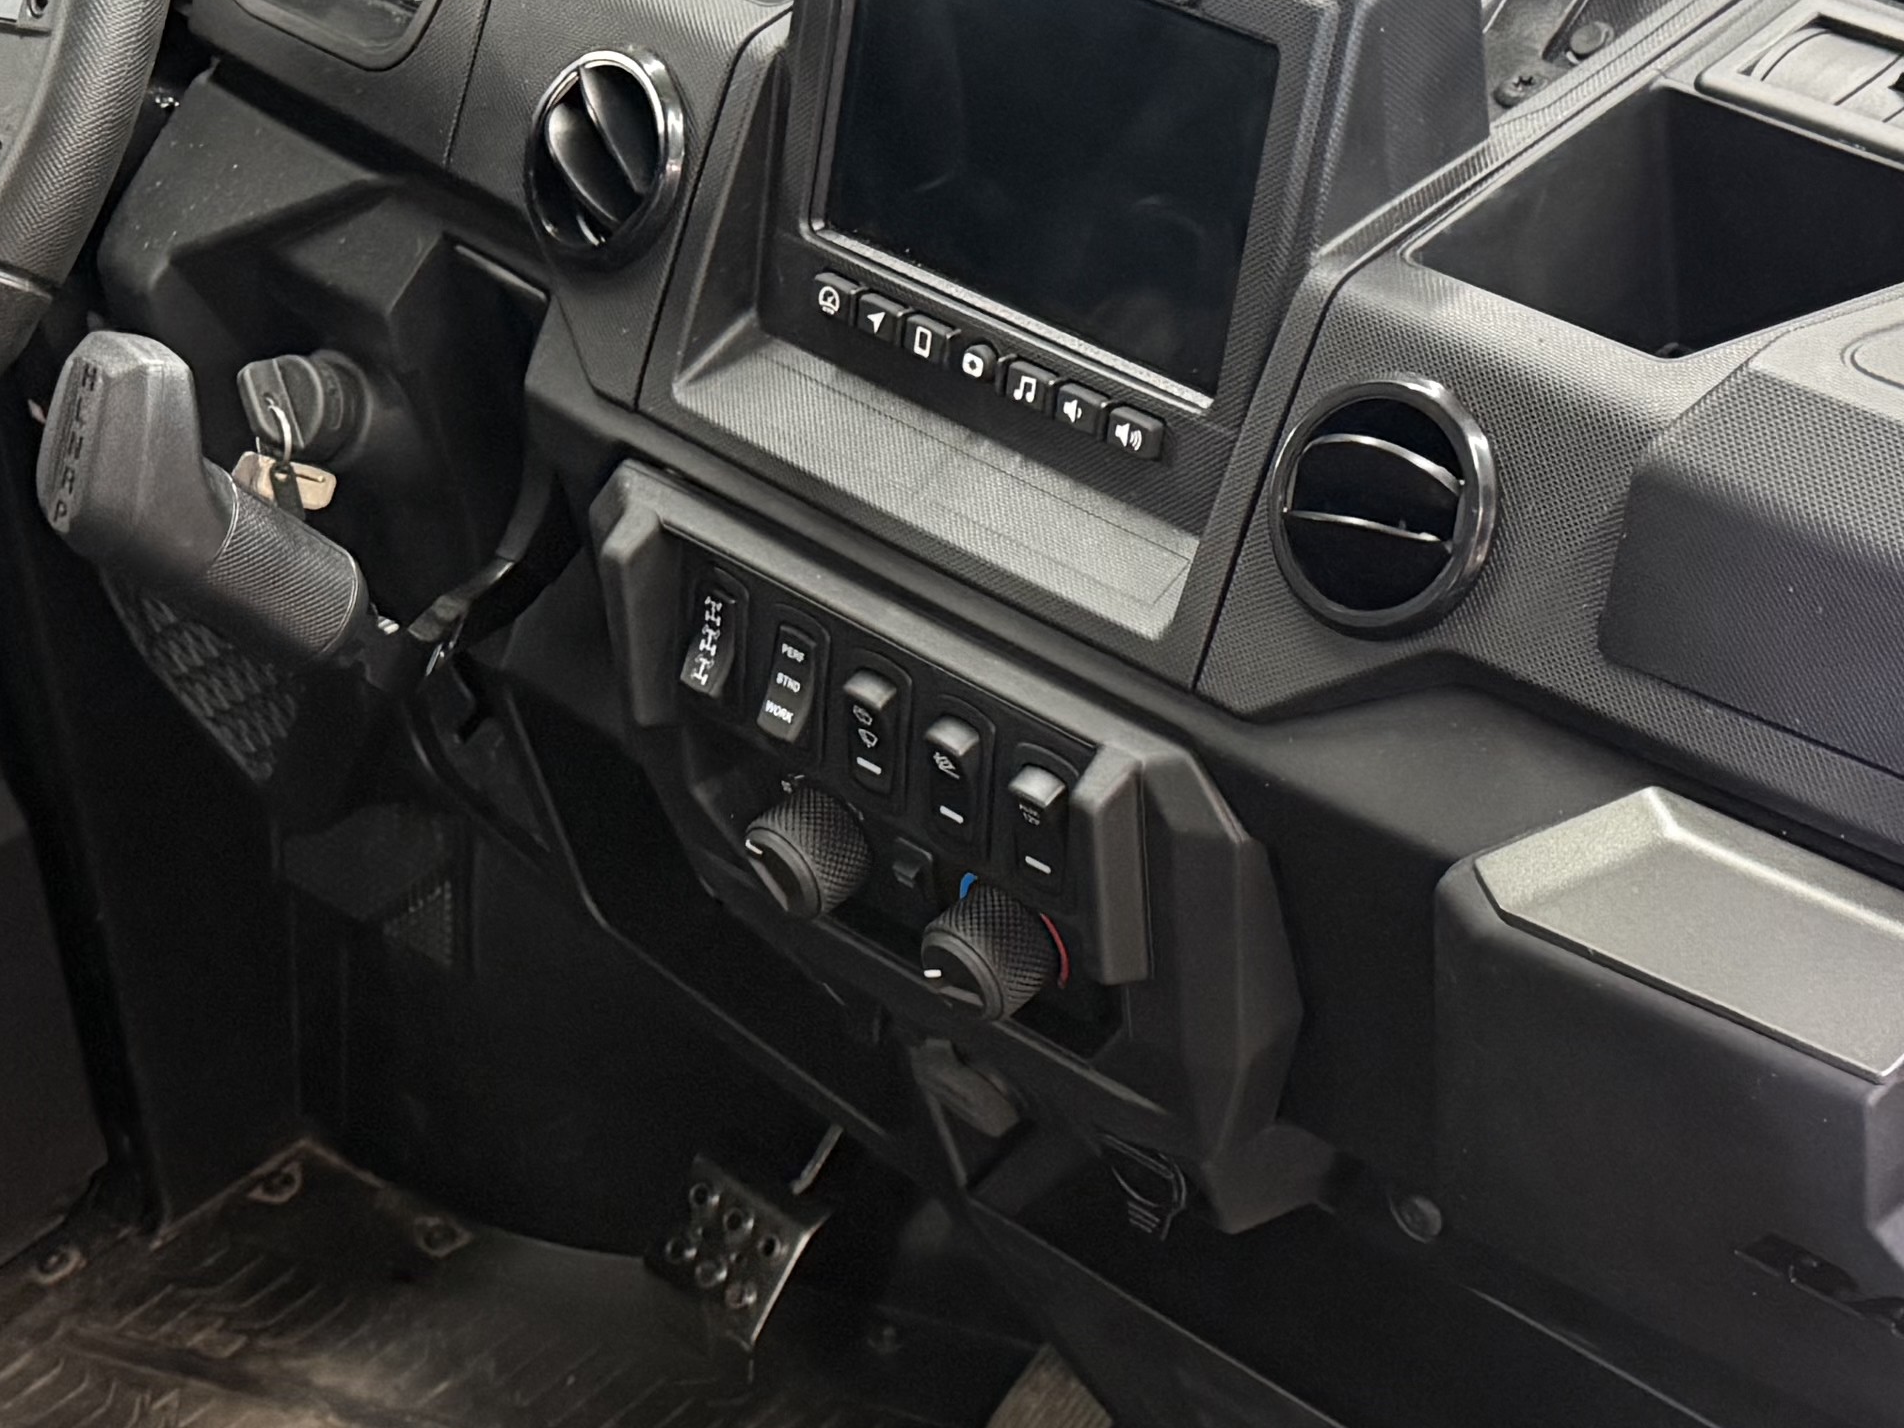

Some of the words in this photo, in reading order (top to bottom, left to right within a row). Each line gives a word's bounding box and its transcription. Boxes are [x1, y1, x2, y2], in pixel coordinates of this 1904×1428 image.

[61, 465, 75, 494] R
[53, 498, 67, 522] P
[764, 699, 794, 725] WORK
